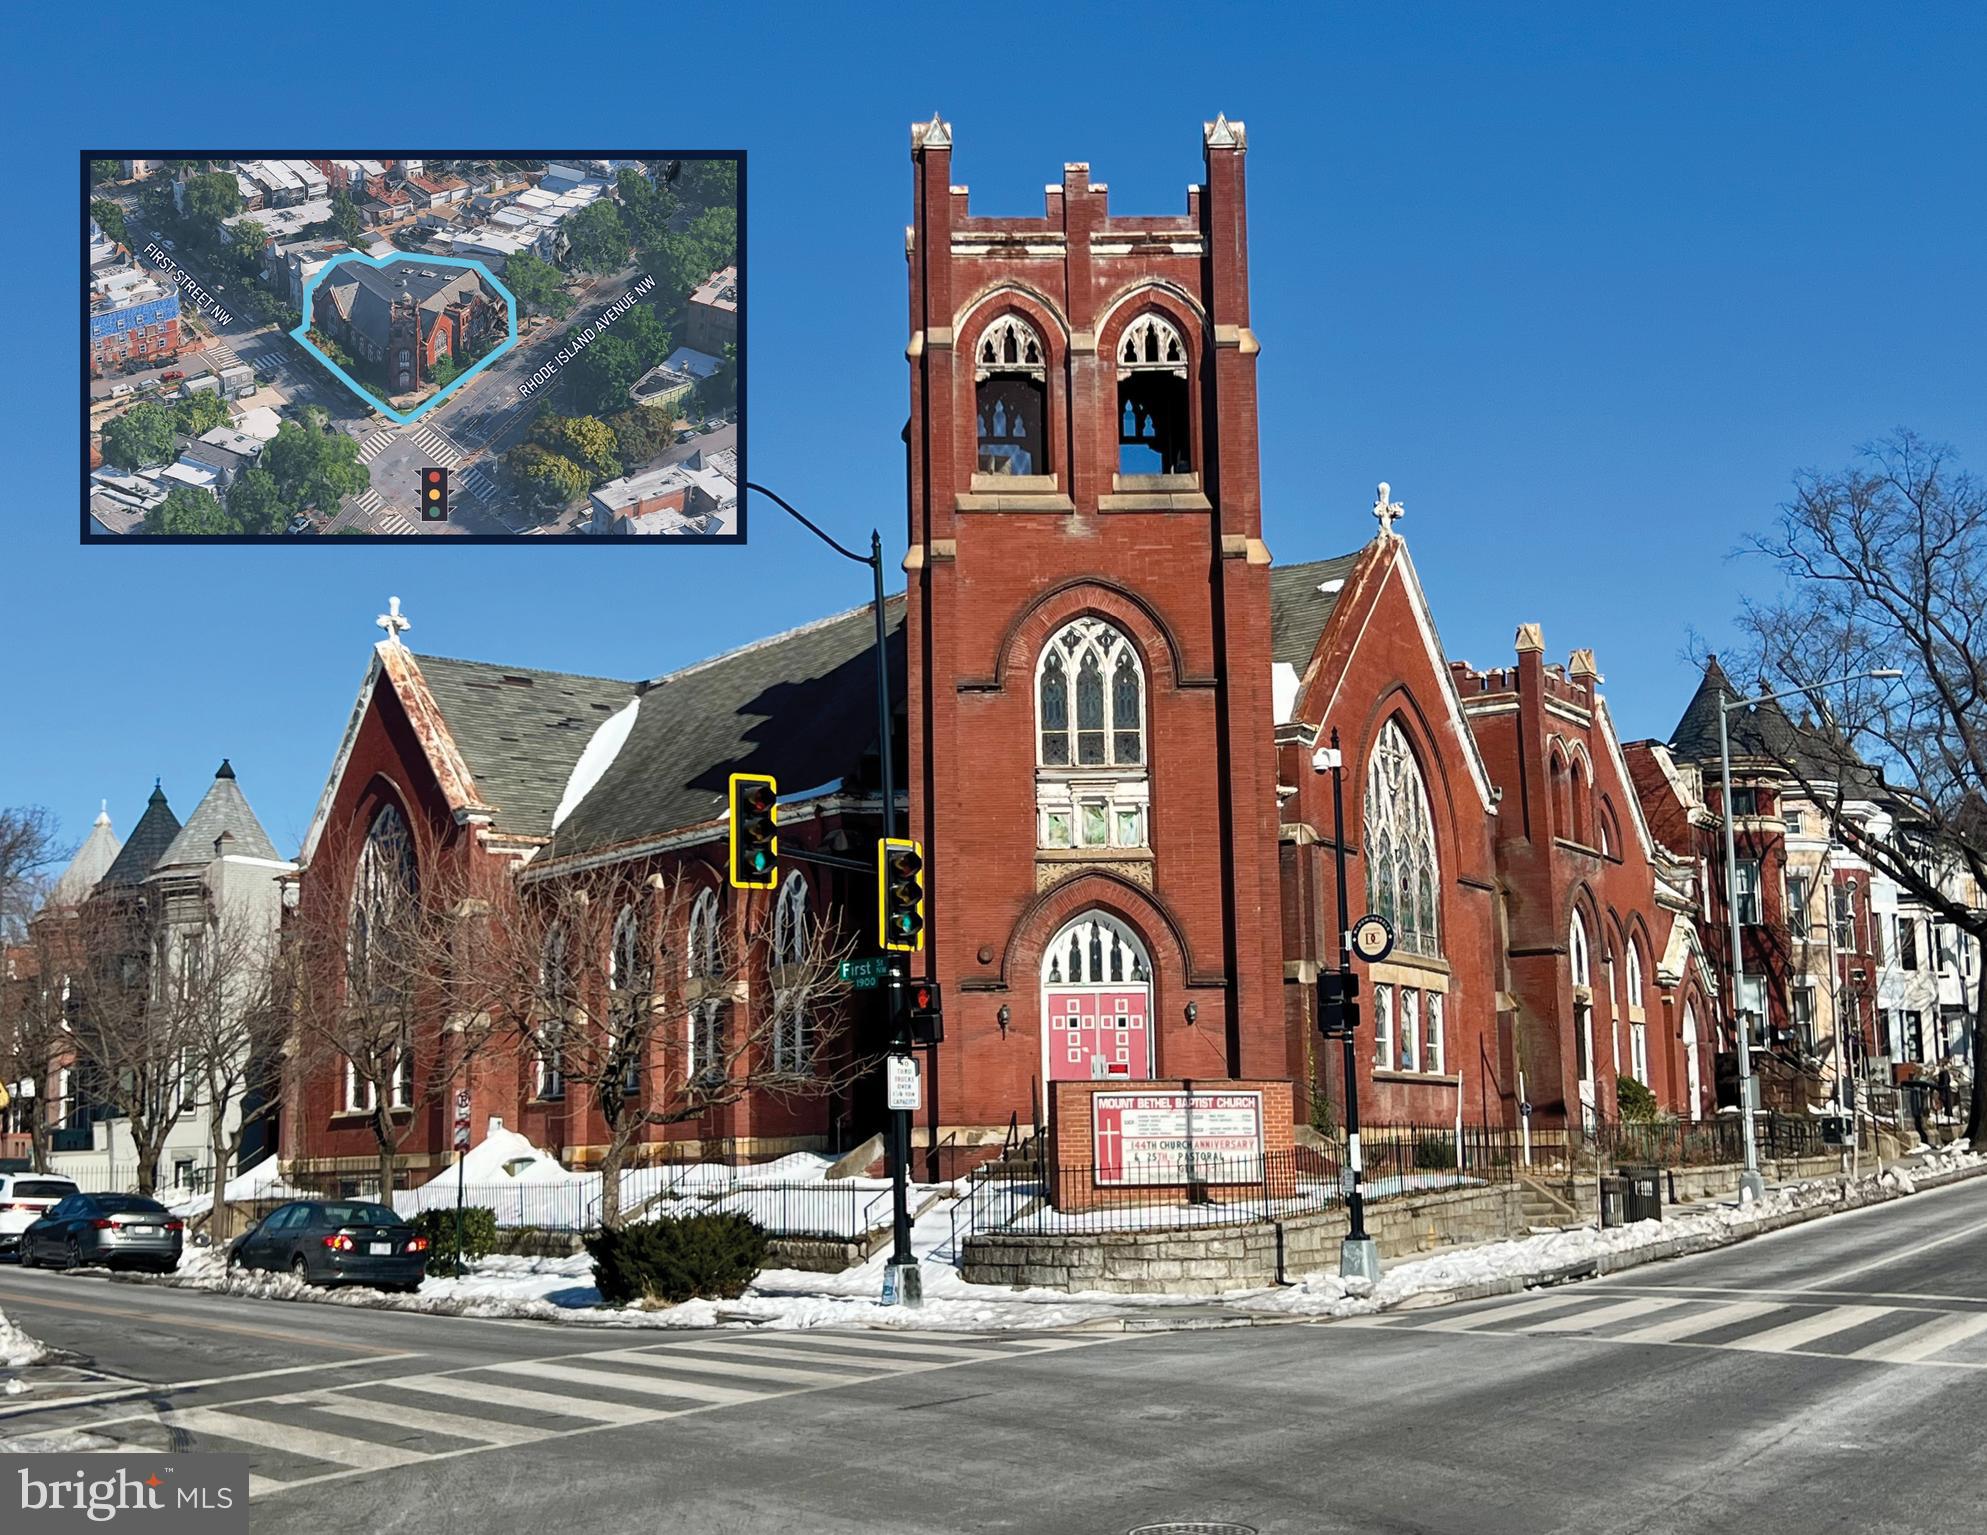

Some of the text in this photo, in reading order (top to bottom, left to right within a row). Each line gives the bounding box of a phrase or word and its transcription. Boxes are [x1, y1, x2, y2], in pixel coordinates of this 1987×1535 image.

[842, 961, 871, 978] First
[856, 976, 876, 987] 1900
[1099, 1097, 1256, 1109] MOUNT BETHEL BAPTIST CHURCH
[1131, 1141, 1255, 1150] 144TH CHURCH ANNIVERSARY
[1148, 1152, 1168, 1161] 25TH
[1178, 1152, 1224, 1161] PASTORAL
